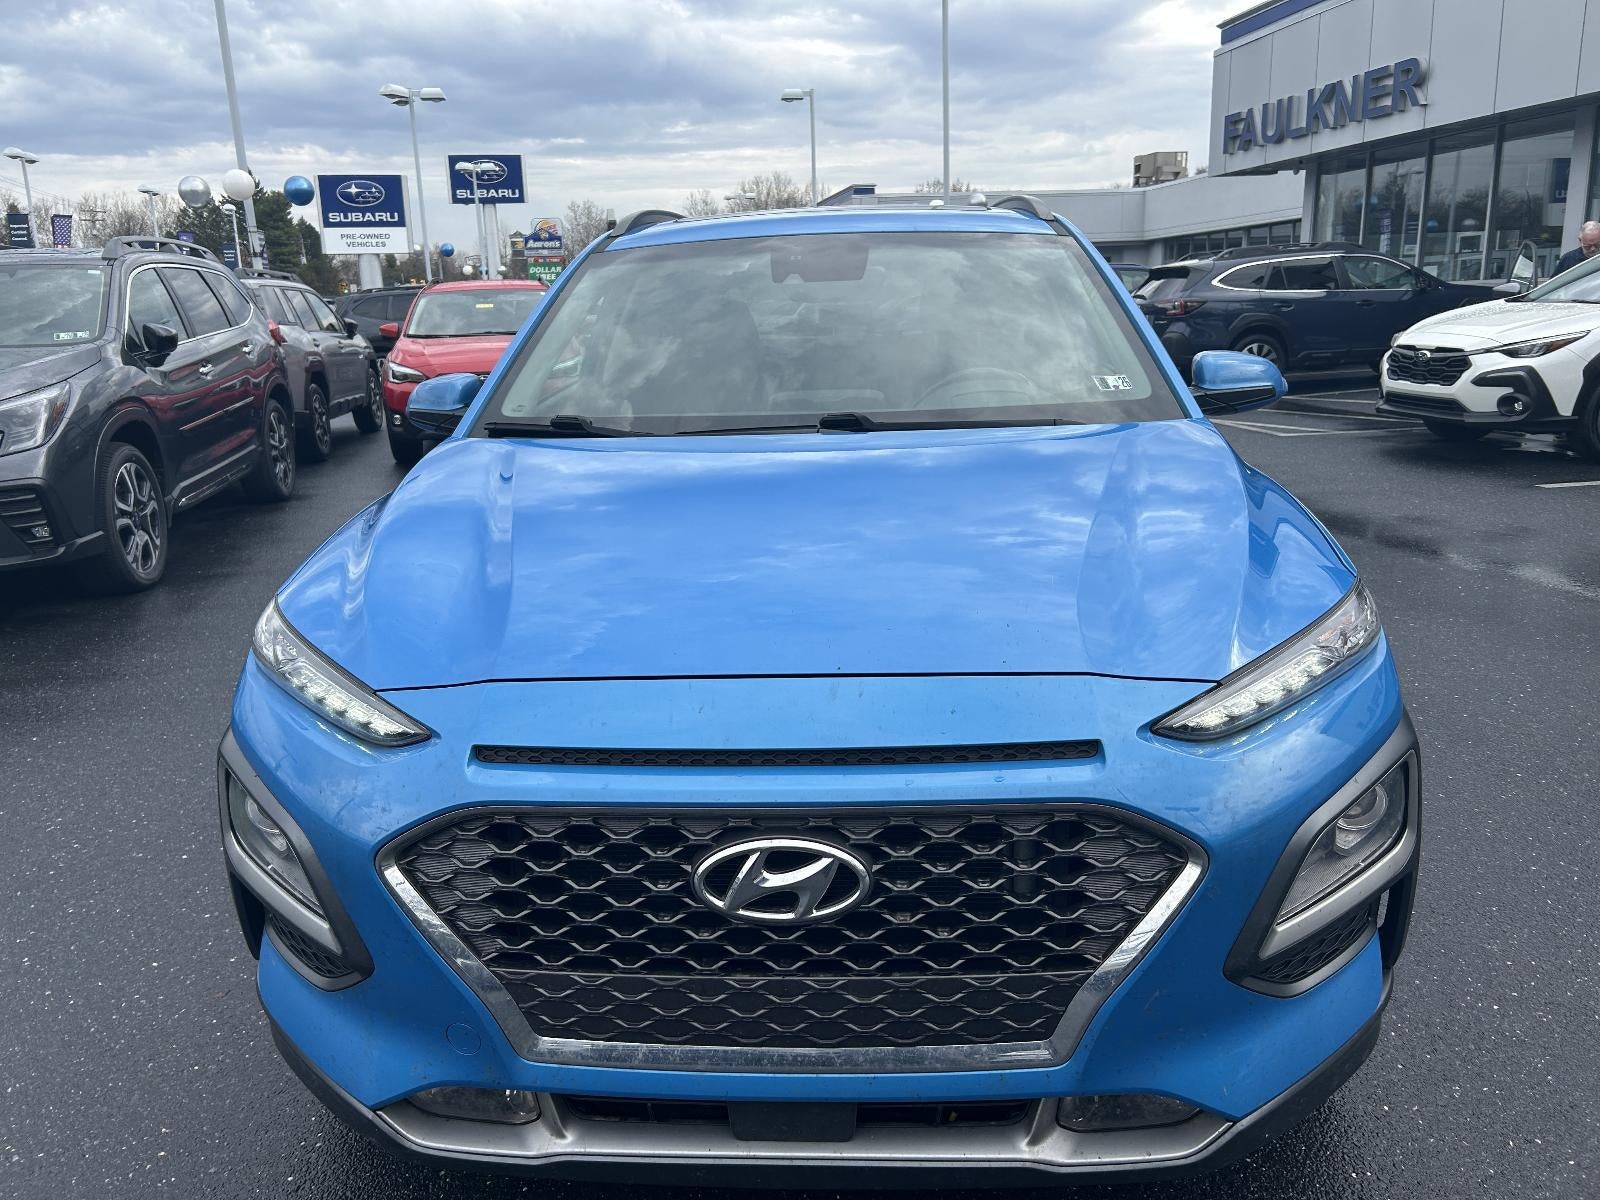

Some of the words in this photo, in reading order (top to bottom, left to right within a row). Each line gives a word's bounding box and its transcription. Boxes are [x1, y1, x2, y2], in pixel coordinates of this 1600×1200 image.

[1223, 57, 1427, 155] FAULKNER
[456, 189, 520, 199] SUBARU
[328, 212, 399, 222] SUBARU
[527, 239, 561, 248] Aaron's
[529, 266, 562, 274] DOLLAR
